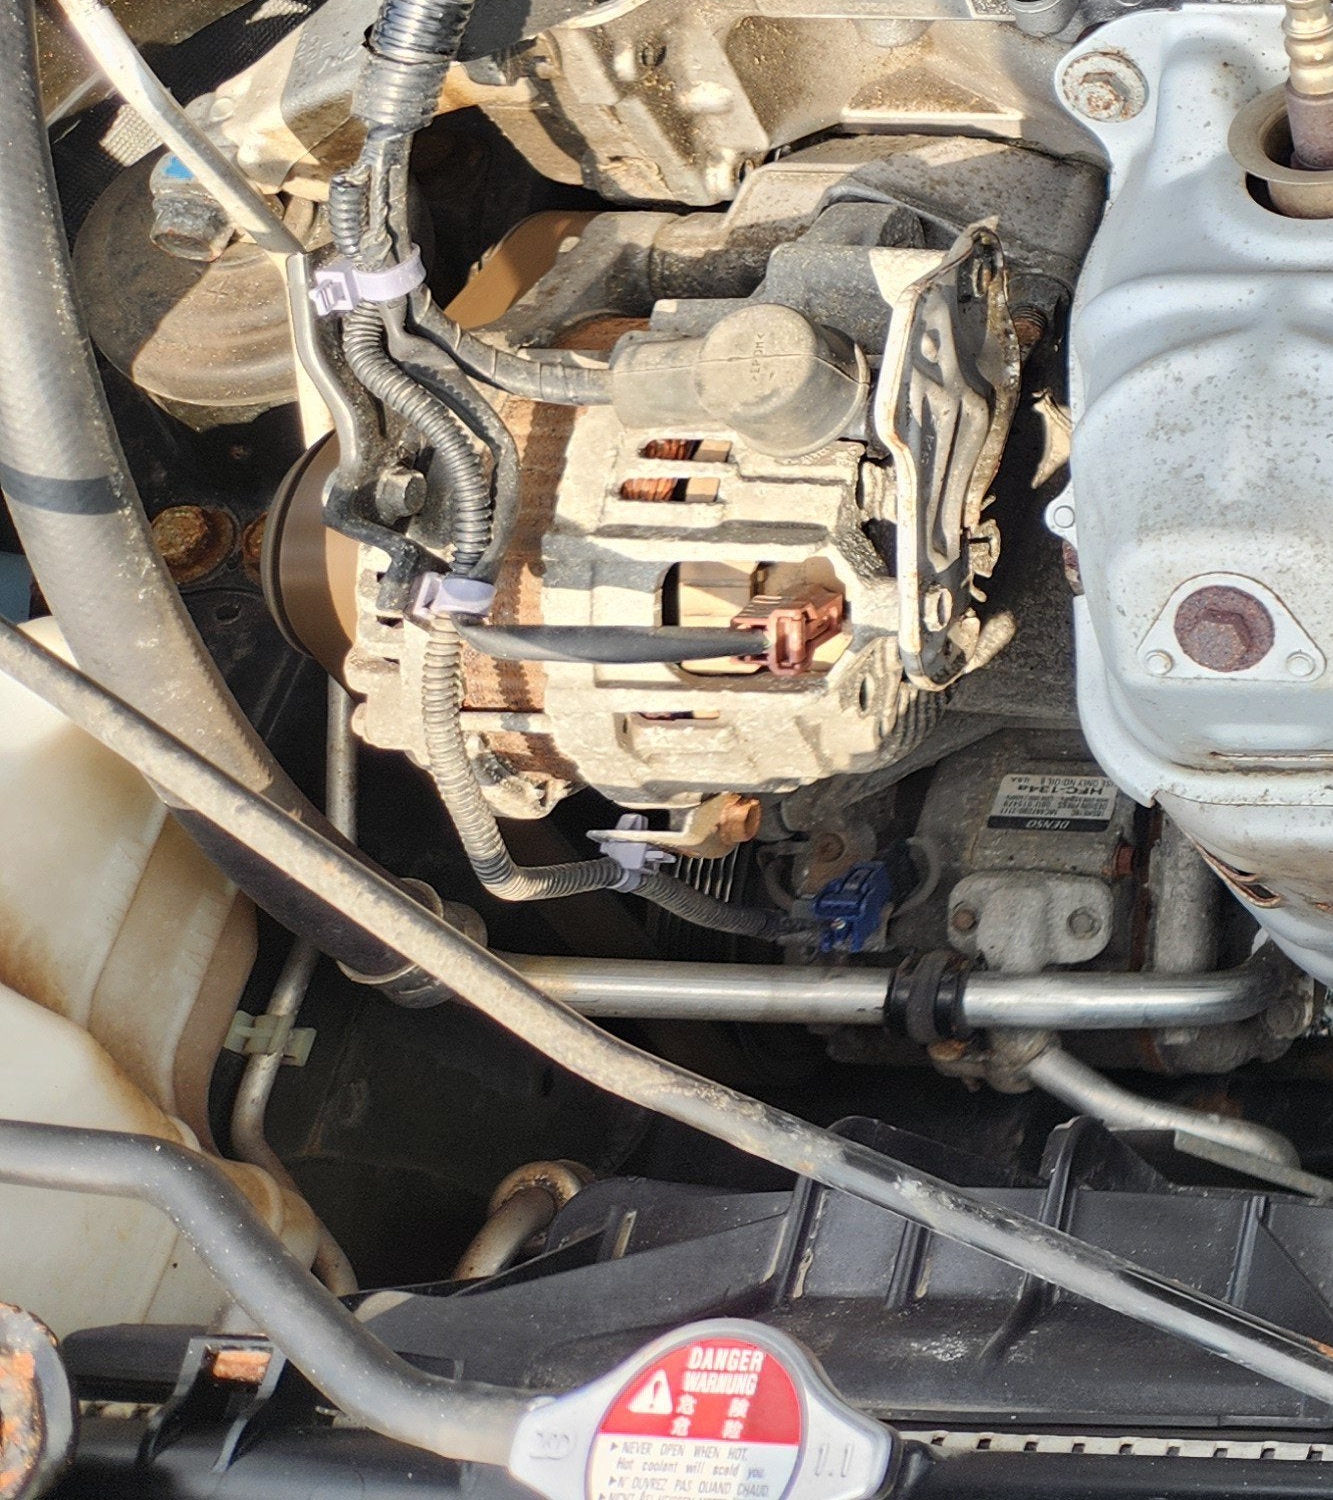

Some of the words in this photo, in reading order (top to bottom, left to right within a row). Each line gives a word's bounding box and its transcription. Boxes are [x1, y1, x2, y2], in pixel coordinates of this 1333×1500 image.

[1017, 785, 1104, 796] HFC-134a
[1025, 819, 1071, 830] DENSO
[687, 1346, 764, 1373] DANGER
[682, 1371, 759, 1396] WARNUNG
[621, 1441, 653, 1456] NEVER
[660, 1443, 684, 1457] OPEN
[694, 1445, 720, 1459] WHEN
[616, 1457, 634, 1471] Hot
[642, 1460, 678, 1474] coolant
[686, 1461, 705, 1476] will
[713, 1463, 740, 1477] scald
[674, 1478, 692, 1493] PAS
[698, 1480, 732, 1495] QUAND
